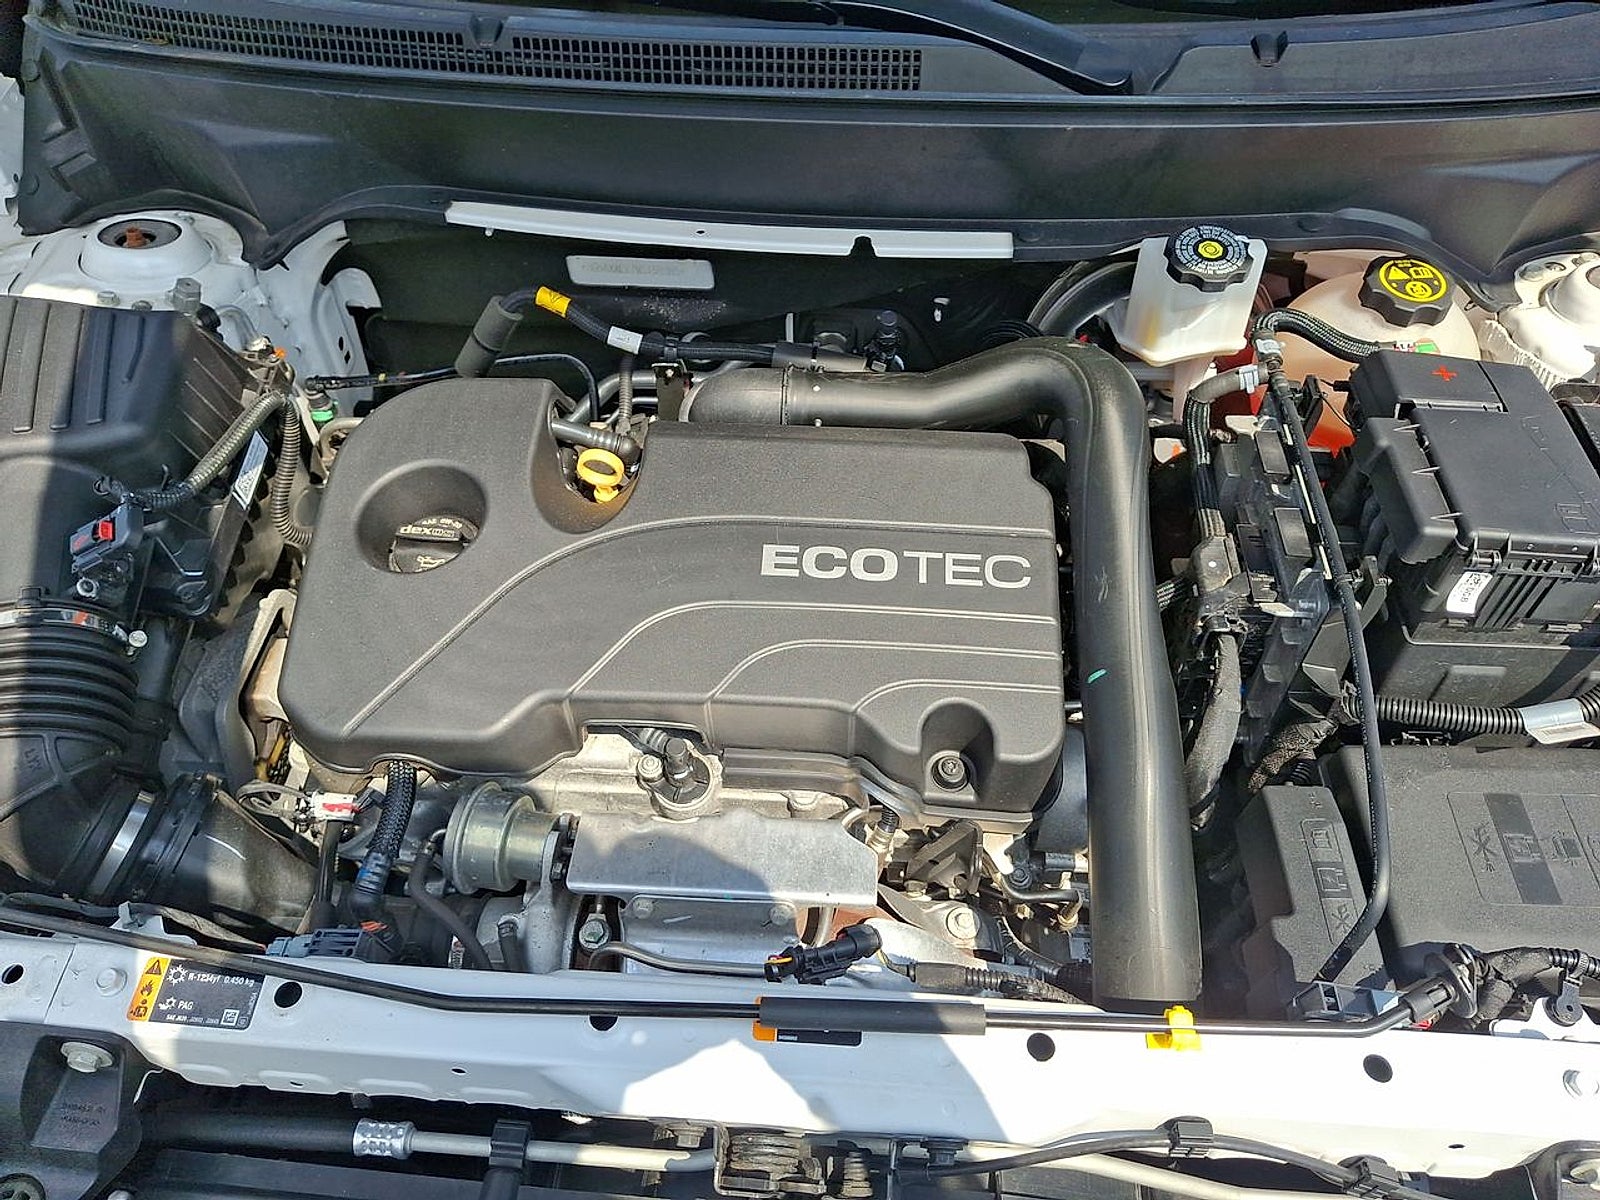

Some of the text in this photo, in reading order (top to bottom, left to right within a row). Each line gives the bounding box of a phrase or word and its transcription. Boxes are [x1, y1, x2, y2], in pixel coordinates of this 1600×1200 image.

[760, 543, 1032, 589] ECOTEC
[188, 973, 255, 987] R-1234yf 0.450 kg
[178, 1001, 194, 1010] PAG
